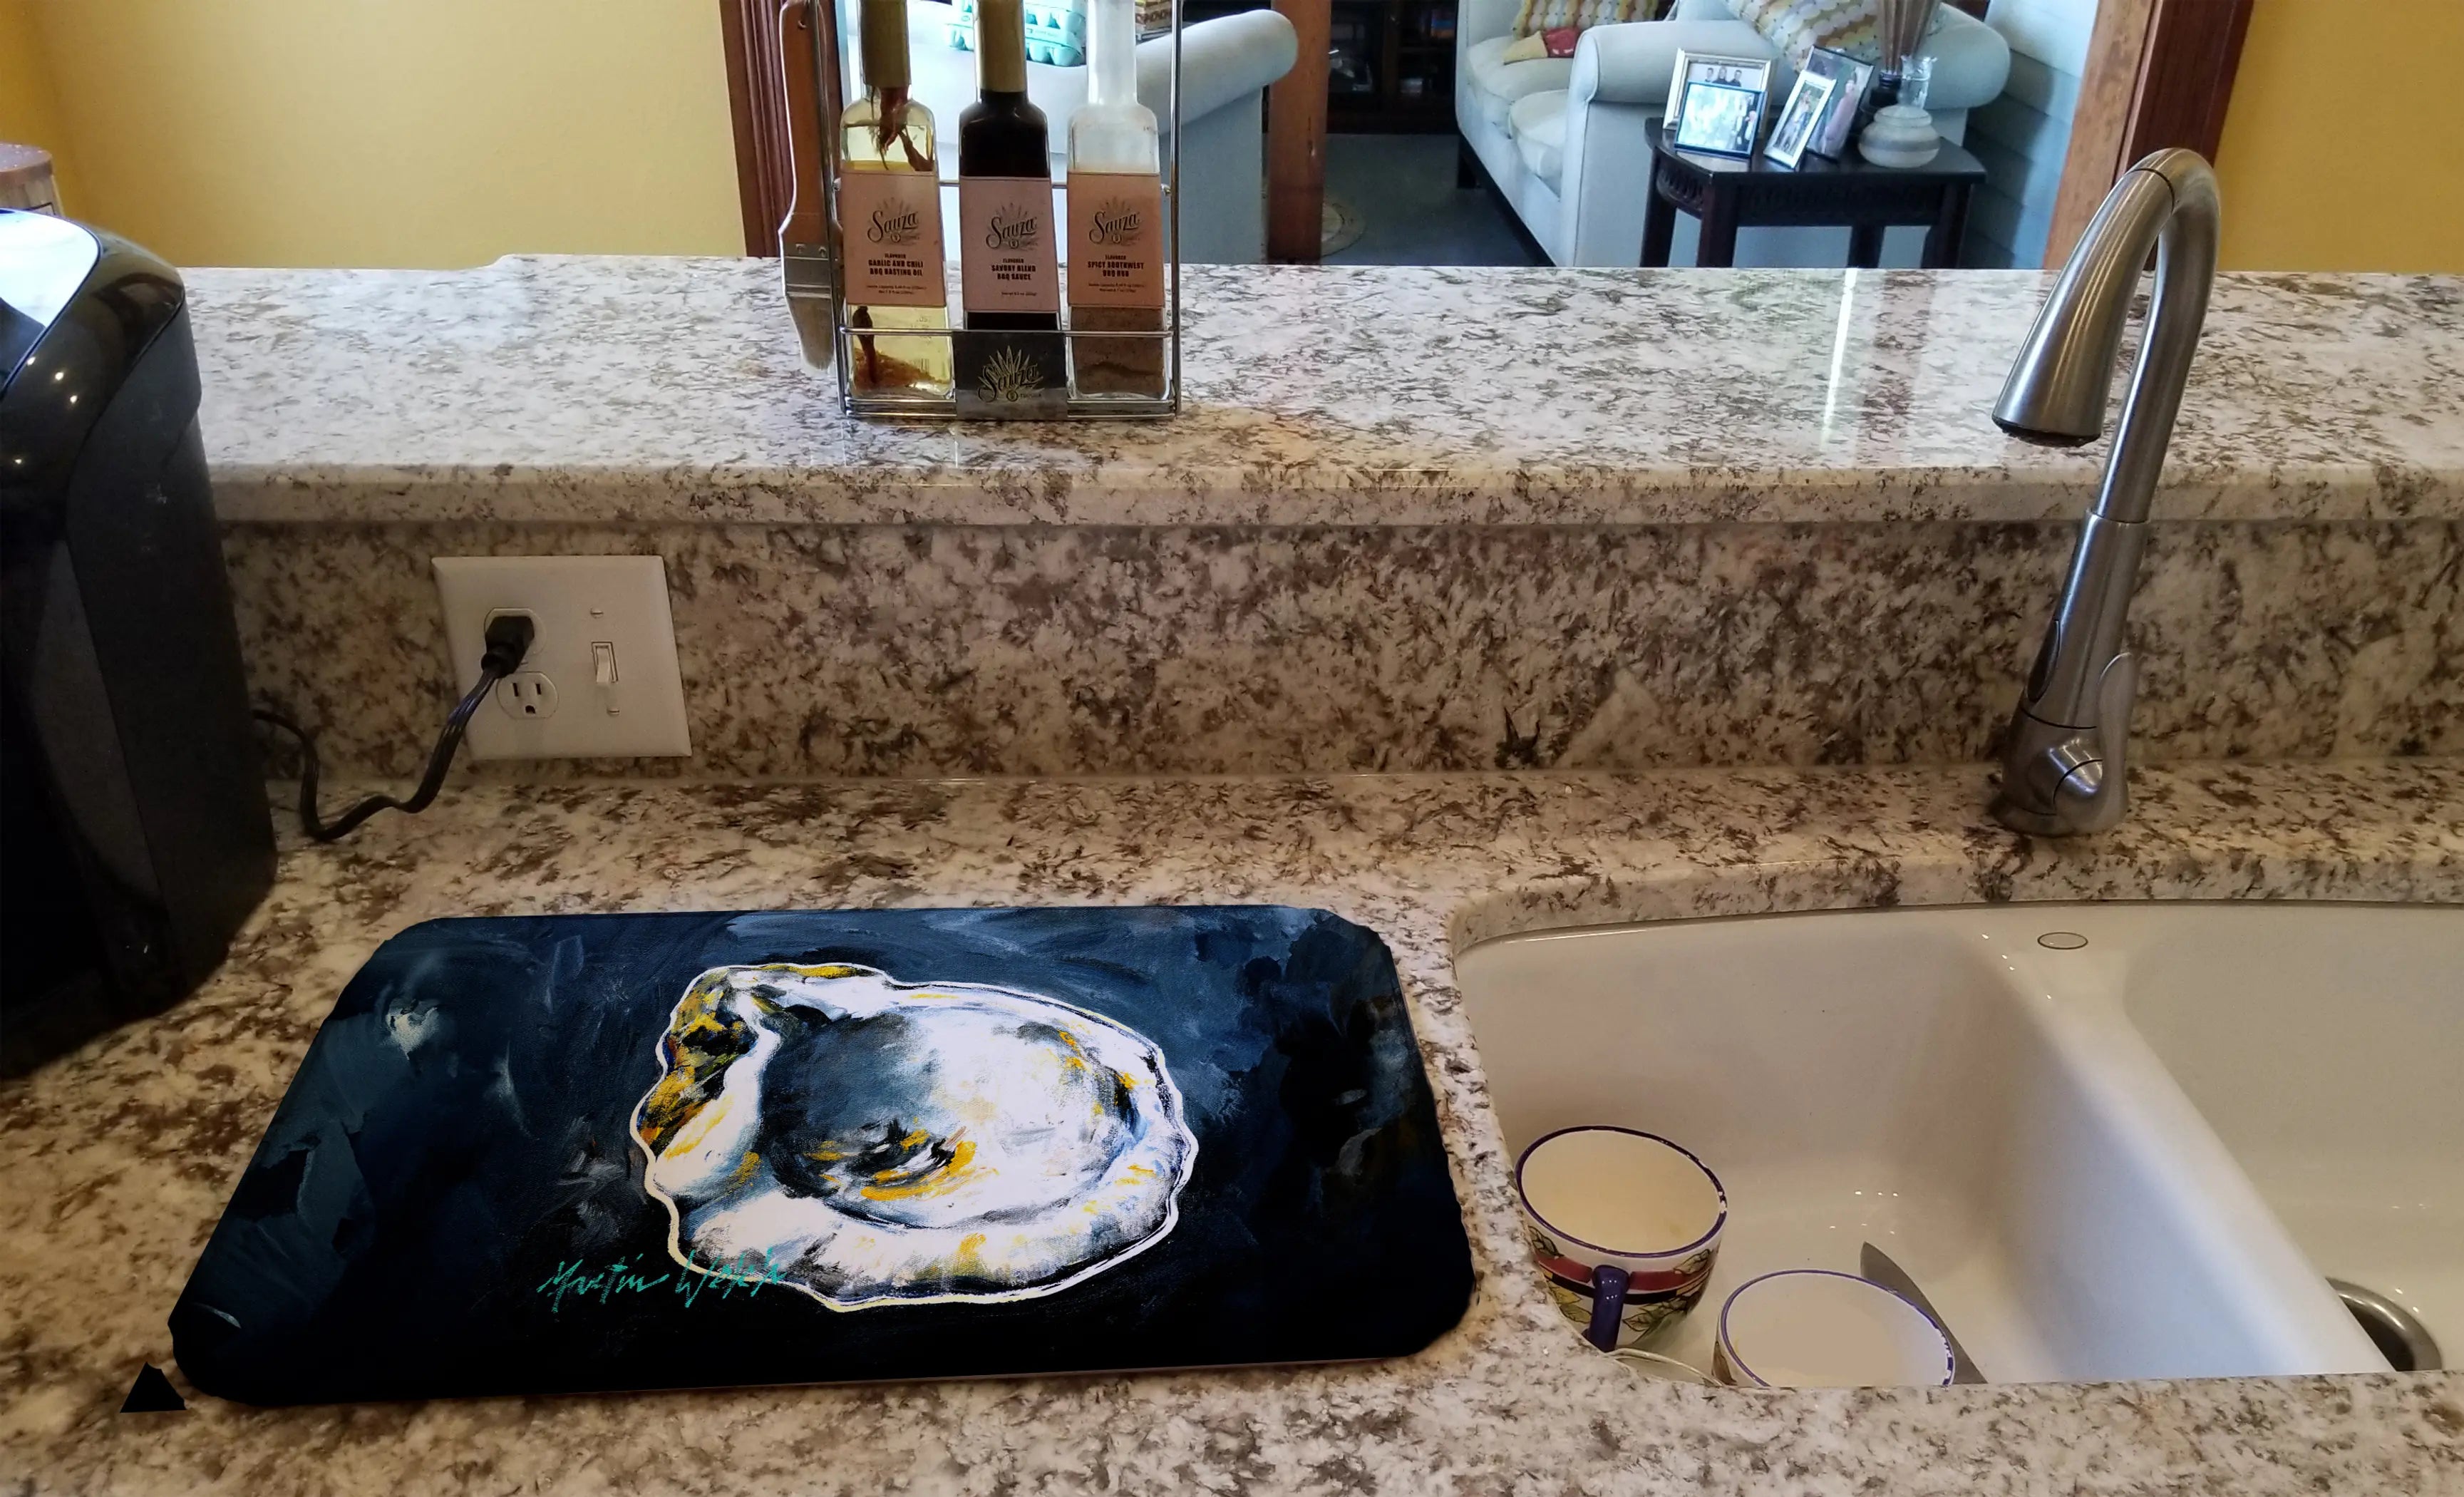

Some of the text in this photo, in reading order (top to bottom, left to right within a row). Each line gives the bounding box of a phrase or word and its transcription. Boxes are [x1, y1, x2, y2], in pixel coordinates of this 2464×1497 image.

[867, 210, 919, 243] Sauza
[985, 216, 1038, 250] Sauza
[1088, 210, 1140, 244] Sauza
[977, 363, 1040, 403] Sauza
